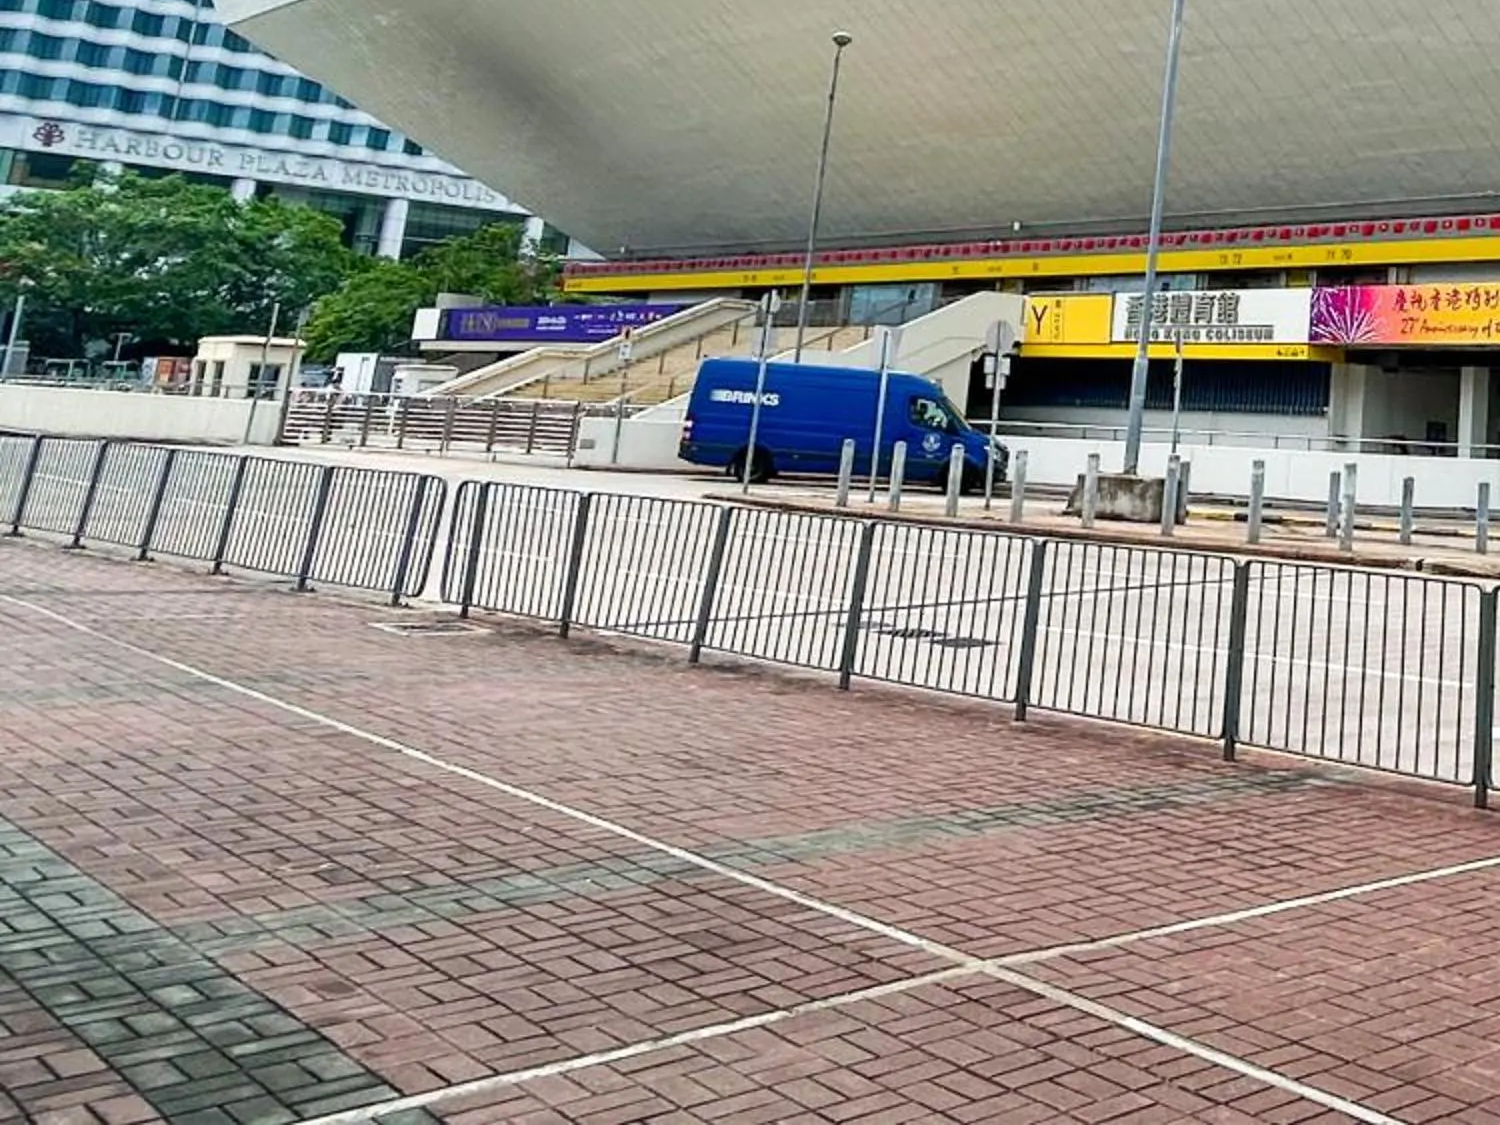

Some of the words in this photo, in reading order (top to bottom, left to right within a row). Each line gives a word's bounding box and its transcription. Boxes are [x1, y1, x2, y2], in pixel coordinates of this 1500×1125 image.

[73, 128, 225, 167] HARBOUR
[239, 152, 327, 181] PLAZA
[341, 166, 496, 203] METROPOLIS
[1031, 304, 1048, 335] Y
[1124, 328, 1159, 340] HOG
[1205, 328, 1274, 341] COLISEUM
